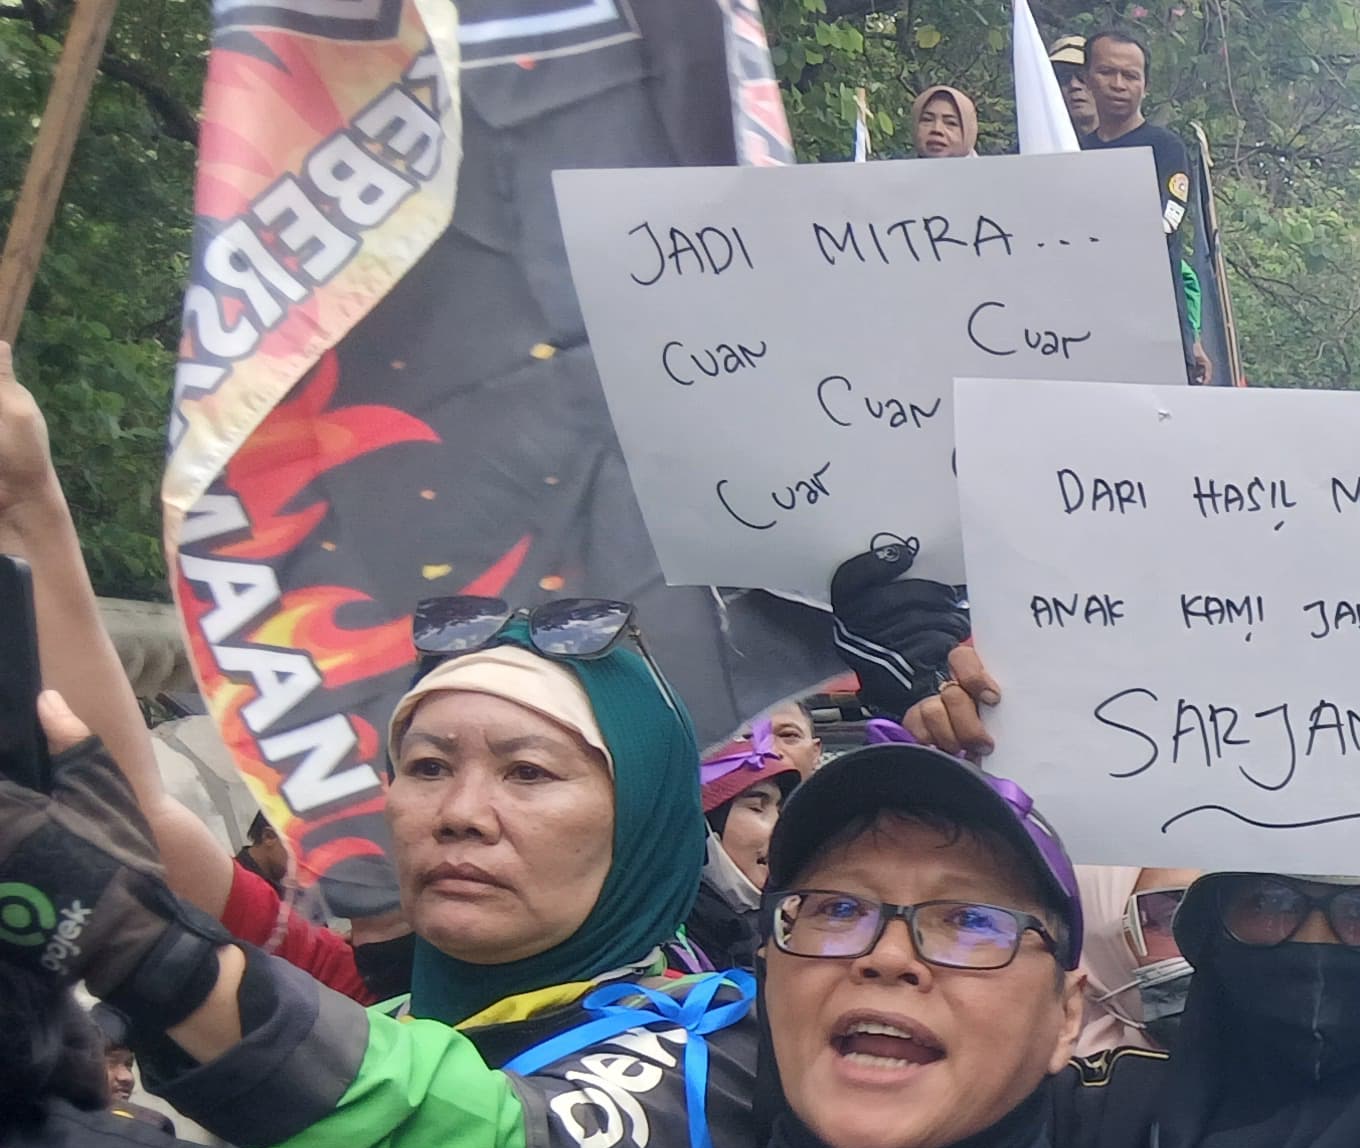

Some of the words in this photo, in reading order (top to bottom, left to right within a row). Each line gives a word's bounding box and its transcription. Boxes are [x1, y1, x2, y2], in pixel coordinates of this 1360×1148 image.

[629, 221, 754, 287] JADI
[1057, 468, 1147, 516] DARI
[1193, 476, 1297, 533] HASIL
[1030, 594, 1126, 630] ANAK
[1180, 593, 1266, 644] KAMI
